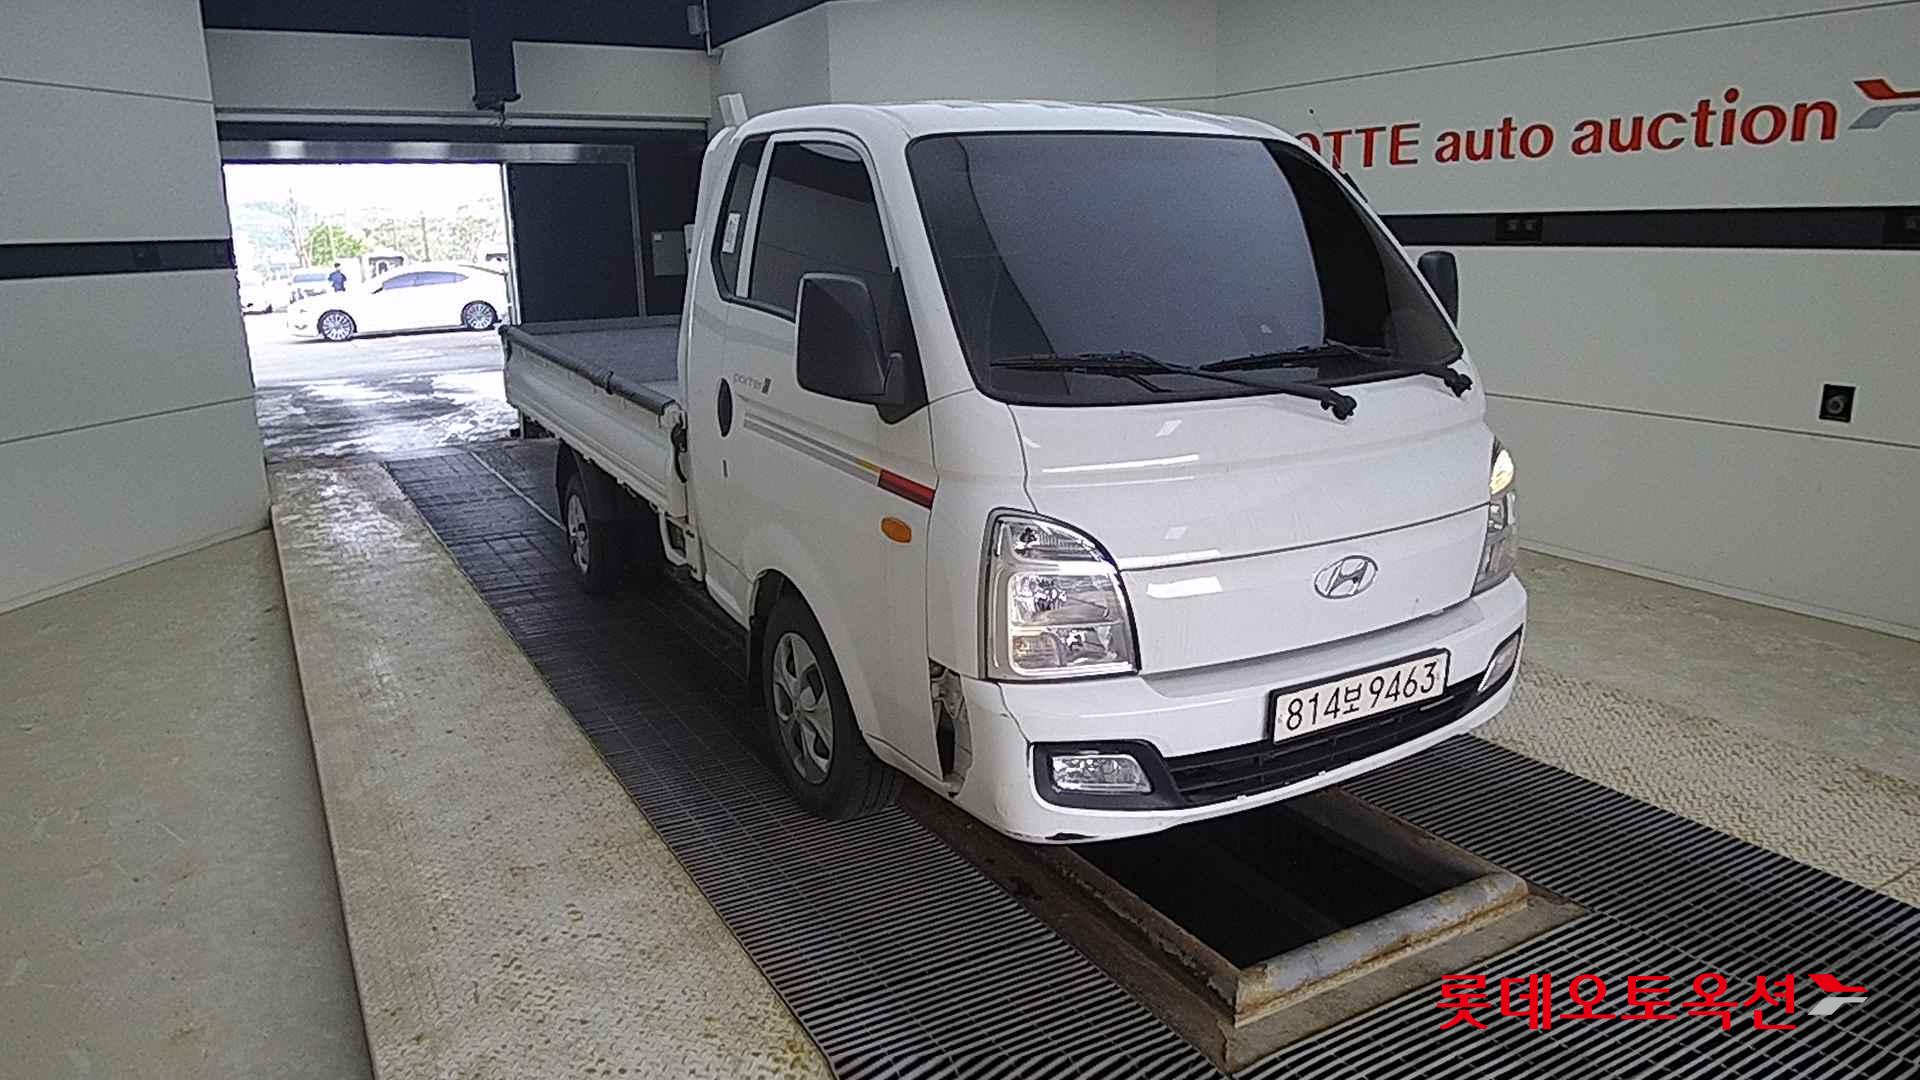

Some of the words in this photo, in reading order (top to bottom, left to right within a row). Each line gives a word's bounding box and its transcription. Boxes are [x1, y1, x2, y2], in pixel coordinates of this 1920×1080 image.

[1435, 117, 1554, 163] auto
[1571, 88, 1838, 157] auction
[1286, 661, 1437, 730] 814보9463
